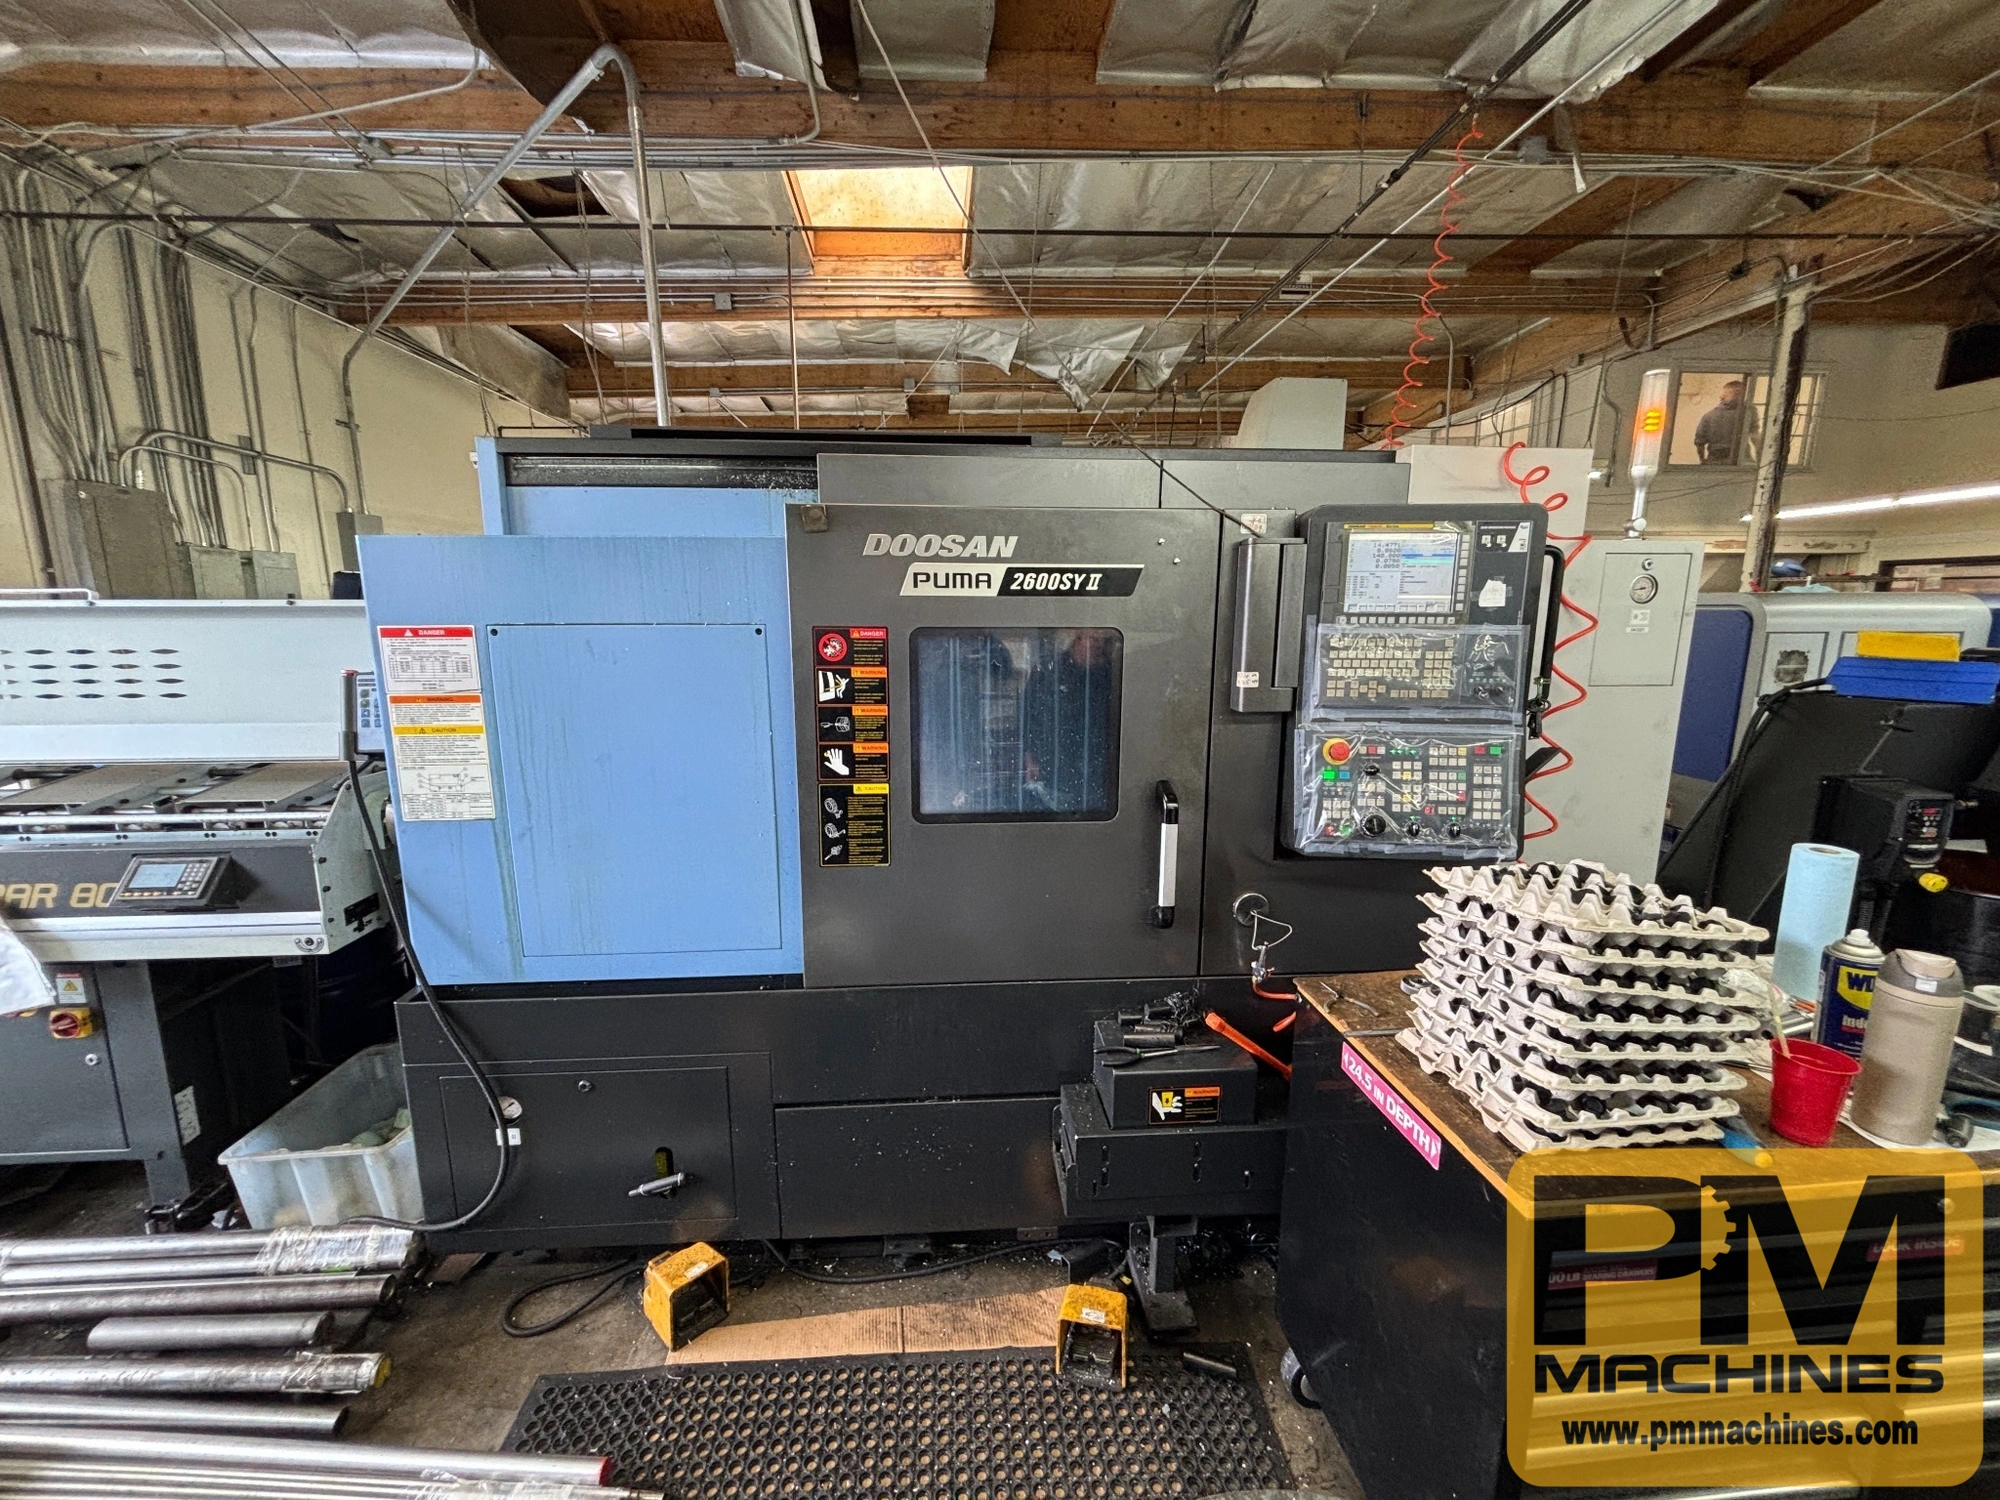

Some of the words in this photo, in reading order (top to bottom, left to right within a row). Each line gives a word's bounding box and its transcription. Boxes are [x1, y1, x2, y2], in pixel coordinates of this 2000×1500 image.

[863, 533, 1018, 558] DOOSAN
[913, 572, 992, 589] PUMA
[0, 883, 58, 909] AR
[1348, 1056, 1373, 1091] 24.5
[1373, 1086, 1385, 1105] IN
[1386, 1095, 1431, 1153] DEPTH
